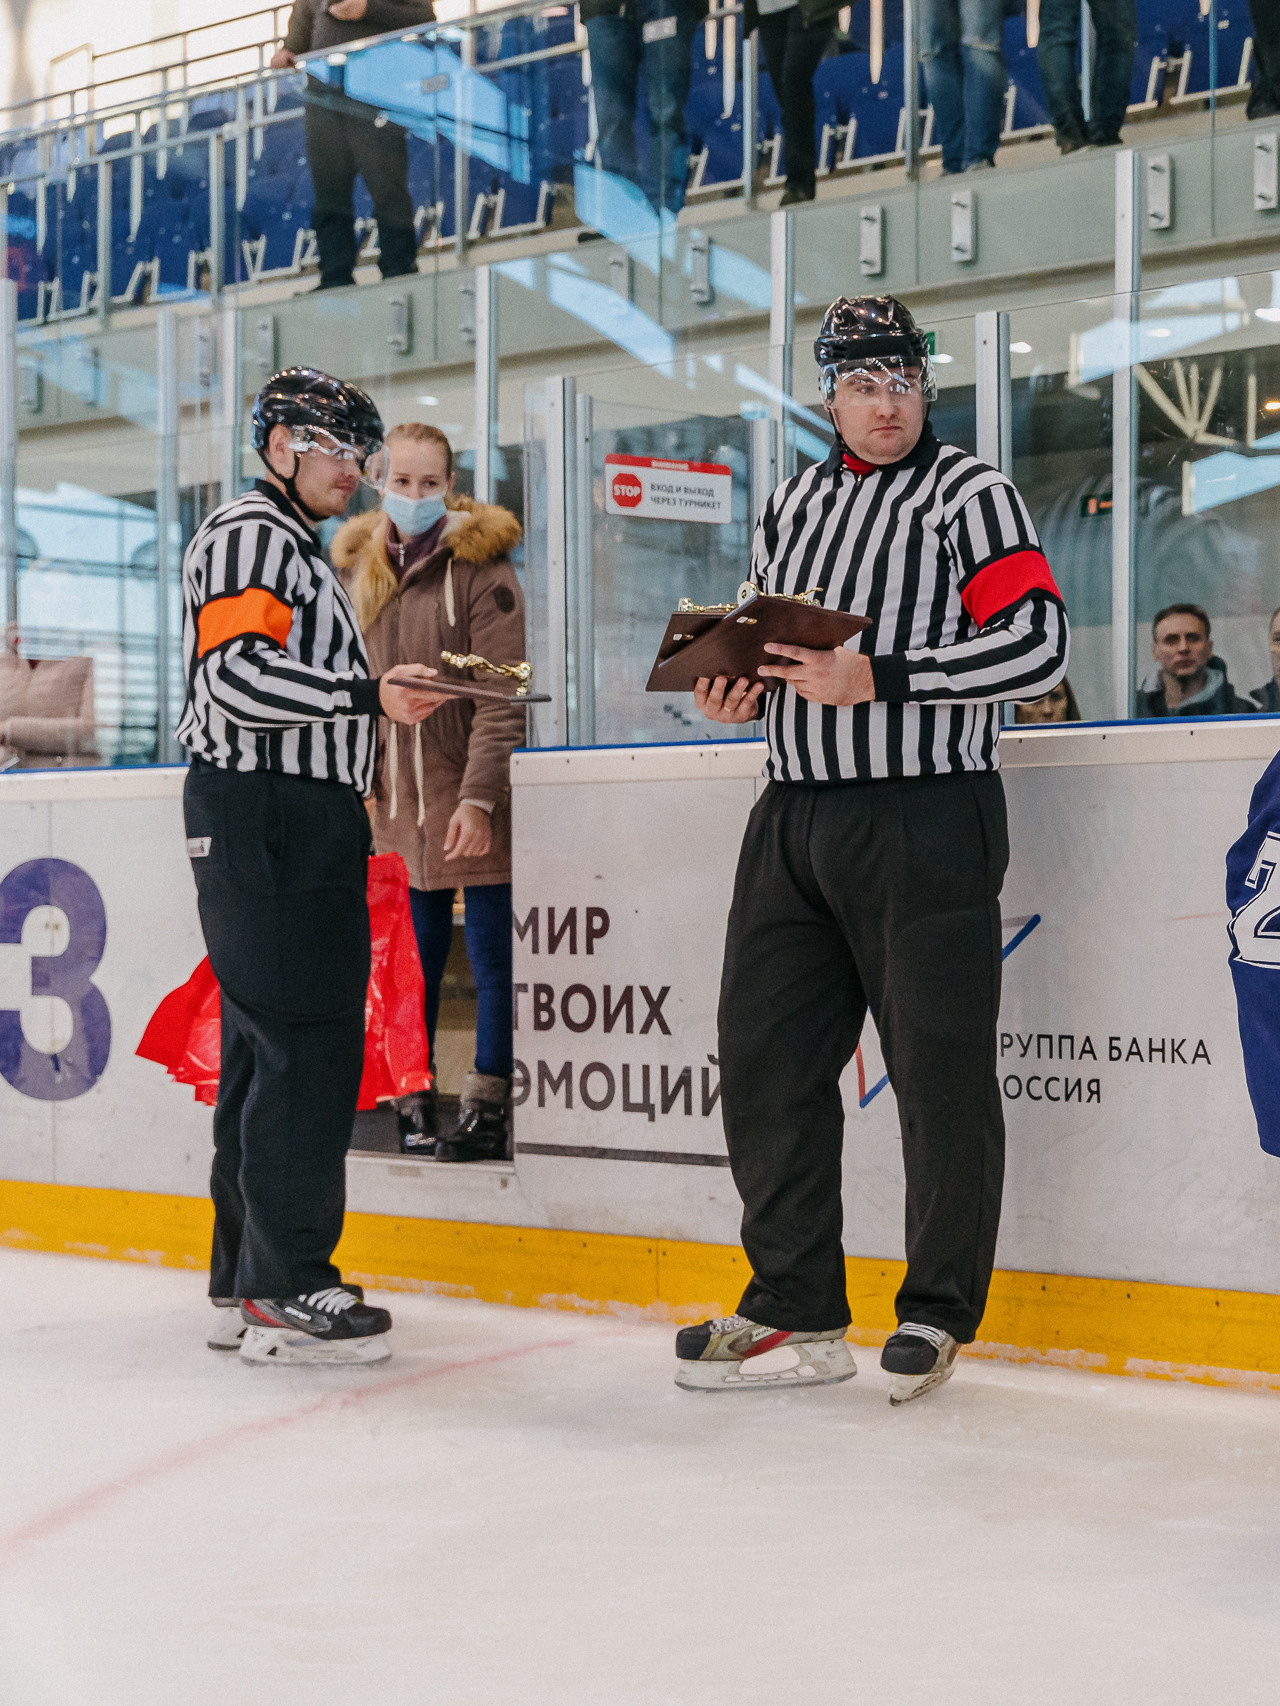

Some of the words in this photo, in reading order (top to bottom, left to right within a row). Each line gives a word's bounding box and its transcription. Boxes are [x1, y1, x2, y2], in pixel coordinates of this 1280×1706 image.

[613, 484, 641, 497] STOP
[650, 483, 674, 493] ВХОД
[683, 486, 715, 498] ВЫХОД
[650, 496, 677, 506] ЧЕРЕЗ
[679, 498, 721, 510] ТУРНИКЕТ
[513, 906, 610, 955] МИР
[0, 857, 112, 1101] 3
[513, 983, 673, 1036] ТВОИХ
[1000, 1032, 1098, 1061] РУППА
[1108, 1036, 1212, 1065] БАНКА
[513, 1053, 721, 1123] ЭМОЦИЙ
[1003, 1074, 1101, 1104] ОССИЯ
